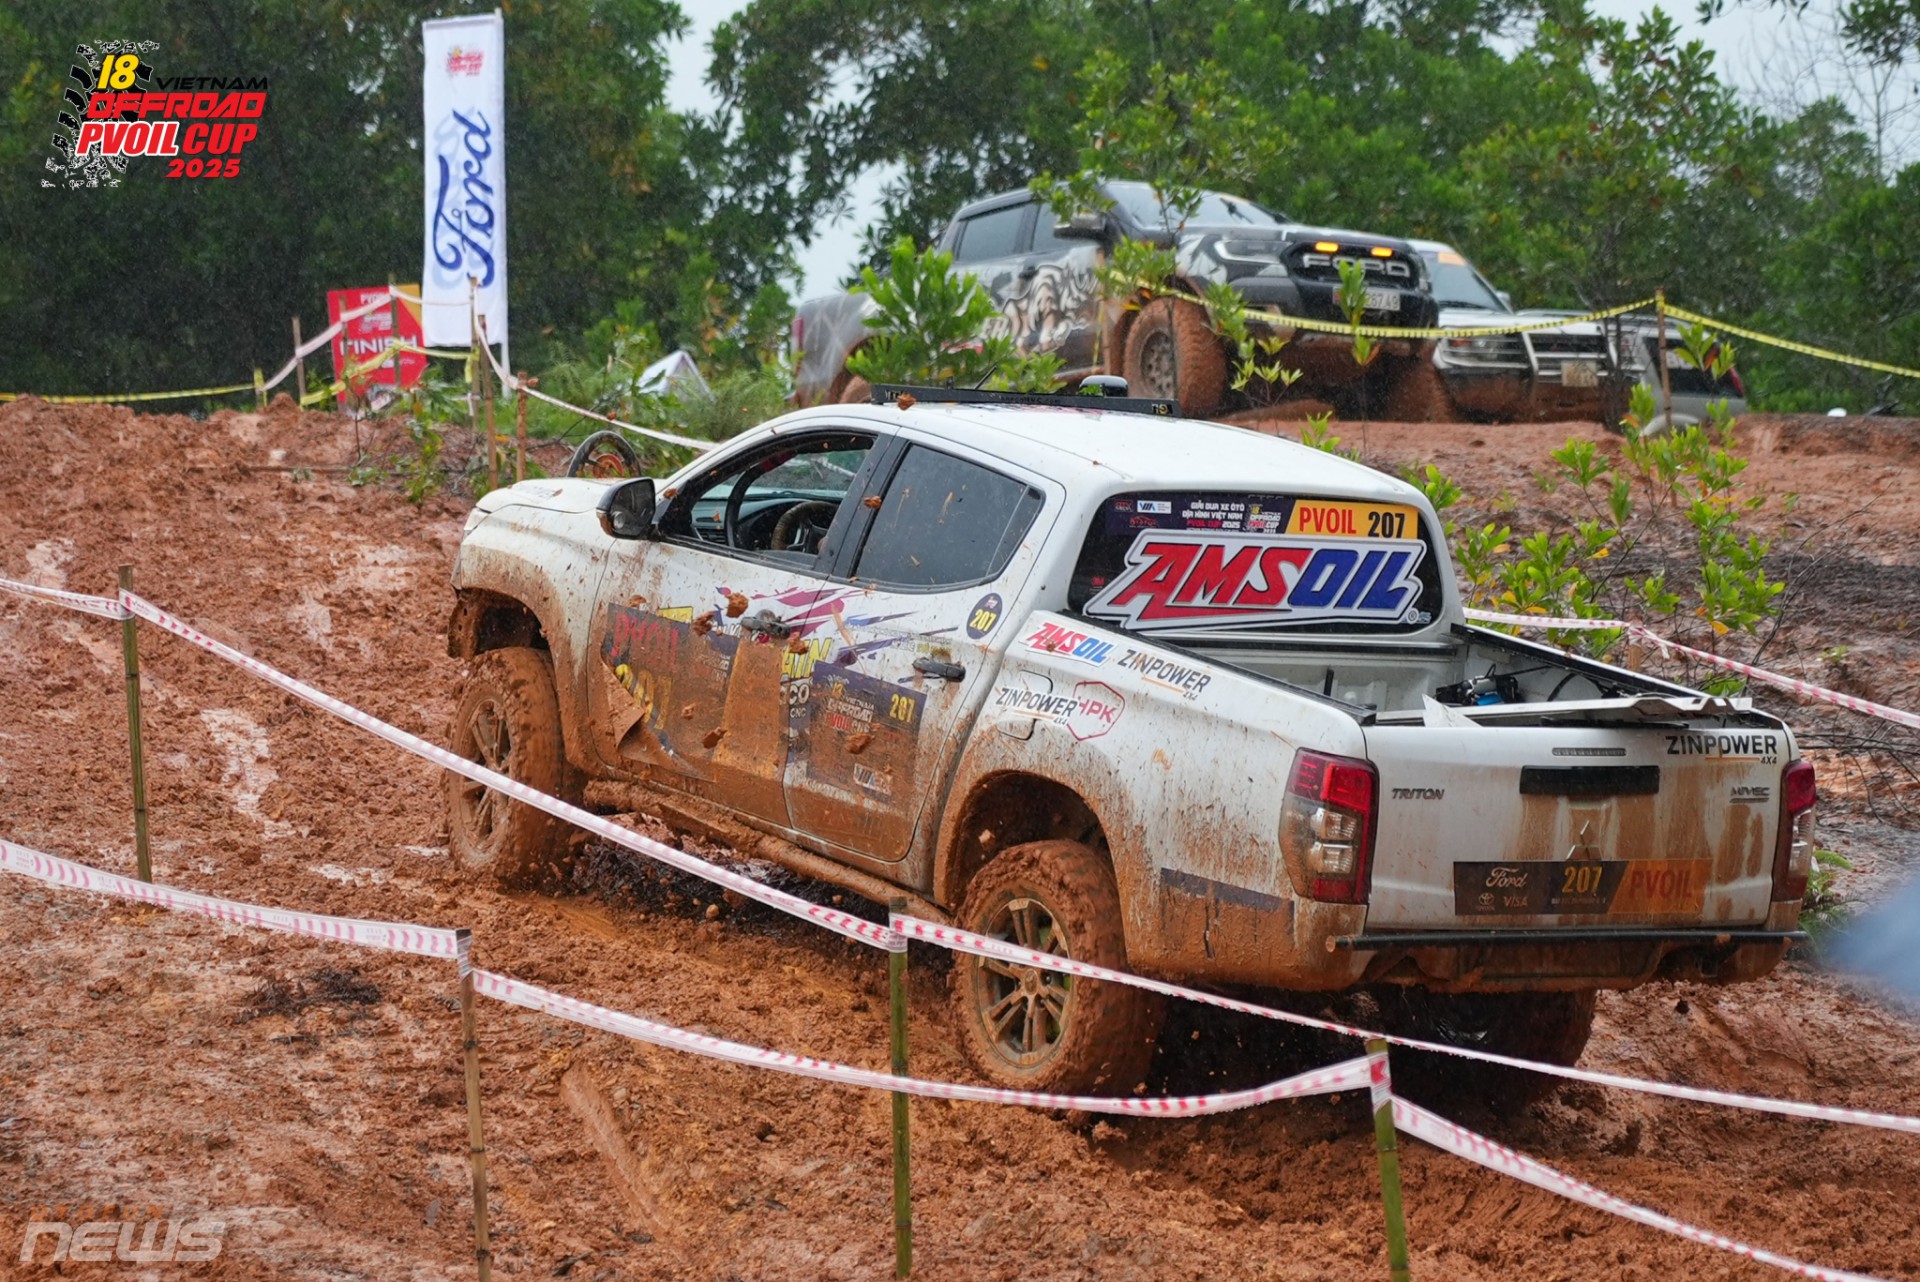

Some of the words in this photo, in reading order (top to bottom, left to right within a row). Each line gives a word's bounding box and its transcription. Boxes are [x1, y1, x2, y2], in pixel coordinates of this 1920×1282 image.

[433, 108, 495, 289] Ford
[1221, 503, 1230, 511] XE
[1299, 506, 1357, 534] PVOIL
[1367, 511, 1406, 539] 207
[1107, 541, 1415, 622] AMSOIL
[969, 609, 998, 632] 207
[1026, 622, 1114, 664] AMSOIL
[1117, 649, 1212, 693] ZINPOWER
[889, 693, 916, 722] 207
[995, 686, 1080, 717] ZINPOWER
[1665, 735, 1778, 755] ZINPOWER
[1760, 756, 1778, 765] 4X4
[1391, 787, 1445, 800] TRITON
[1485, 867, 1529, 889] Ford
[1562, 865, 1604, 894] 207
[1628, 870, 1693, 900] PVOIL
[1503, 895, 1529, 907] VISA
